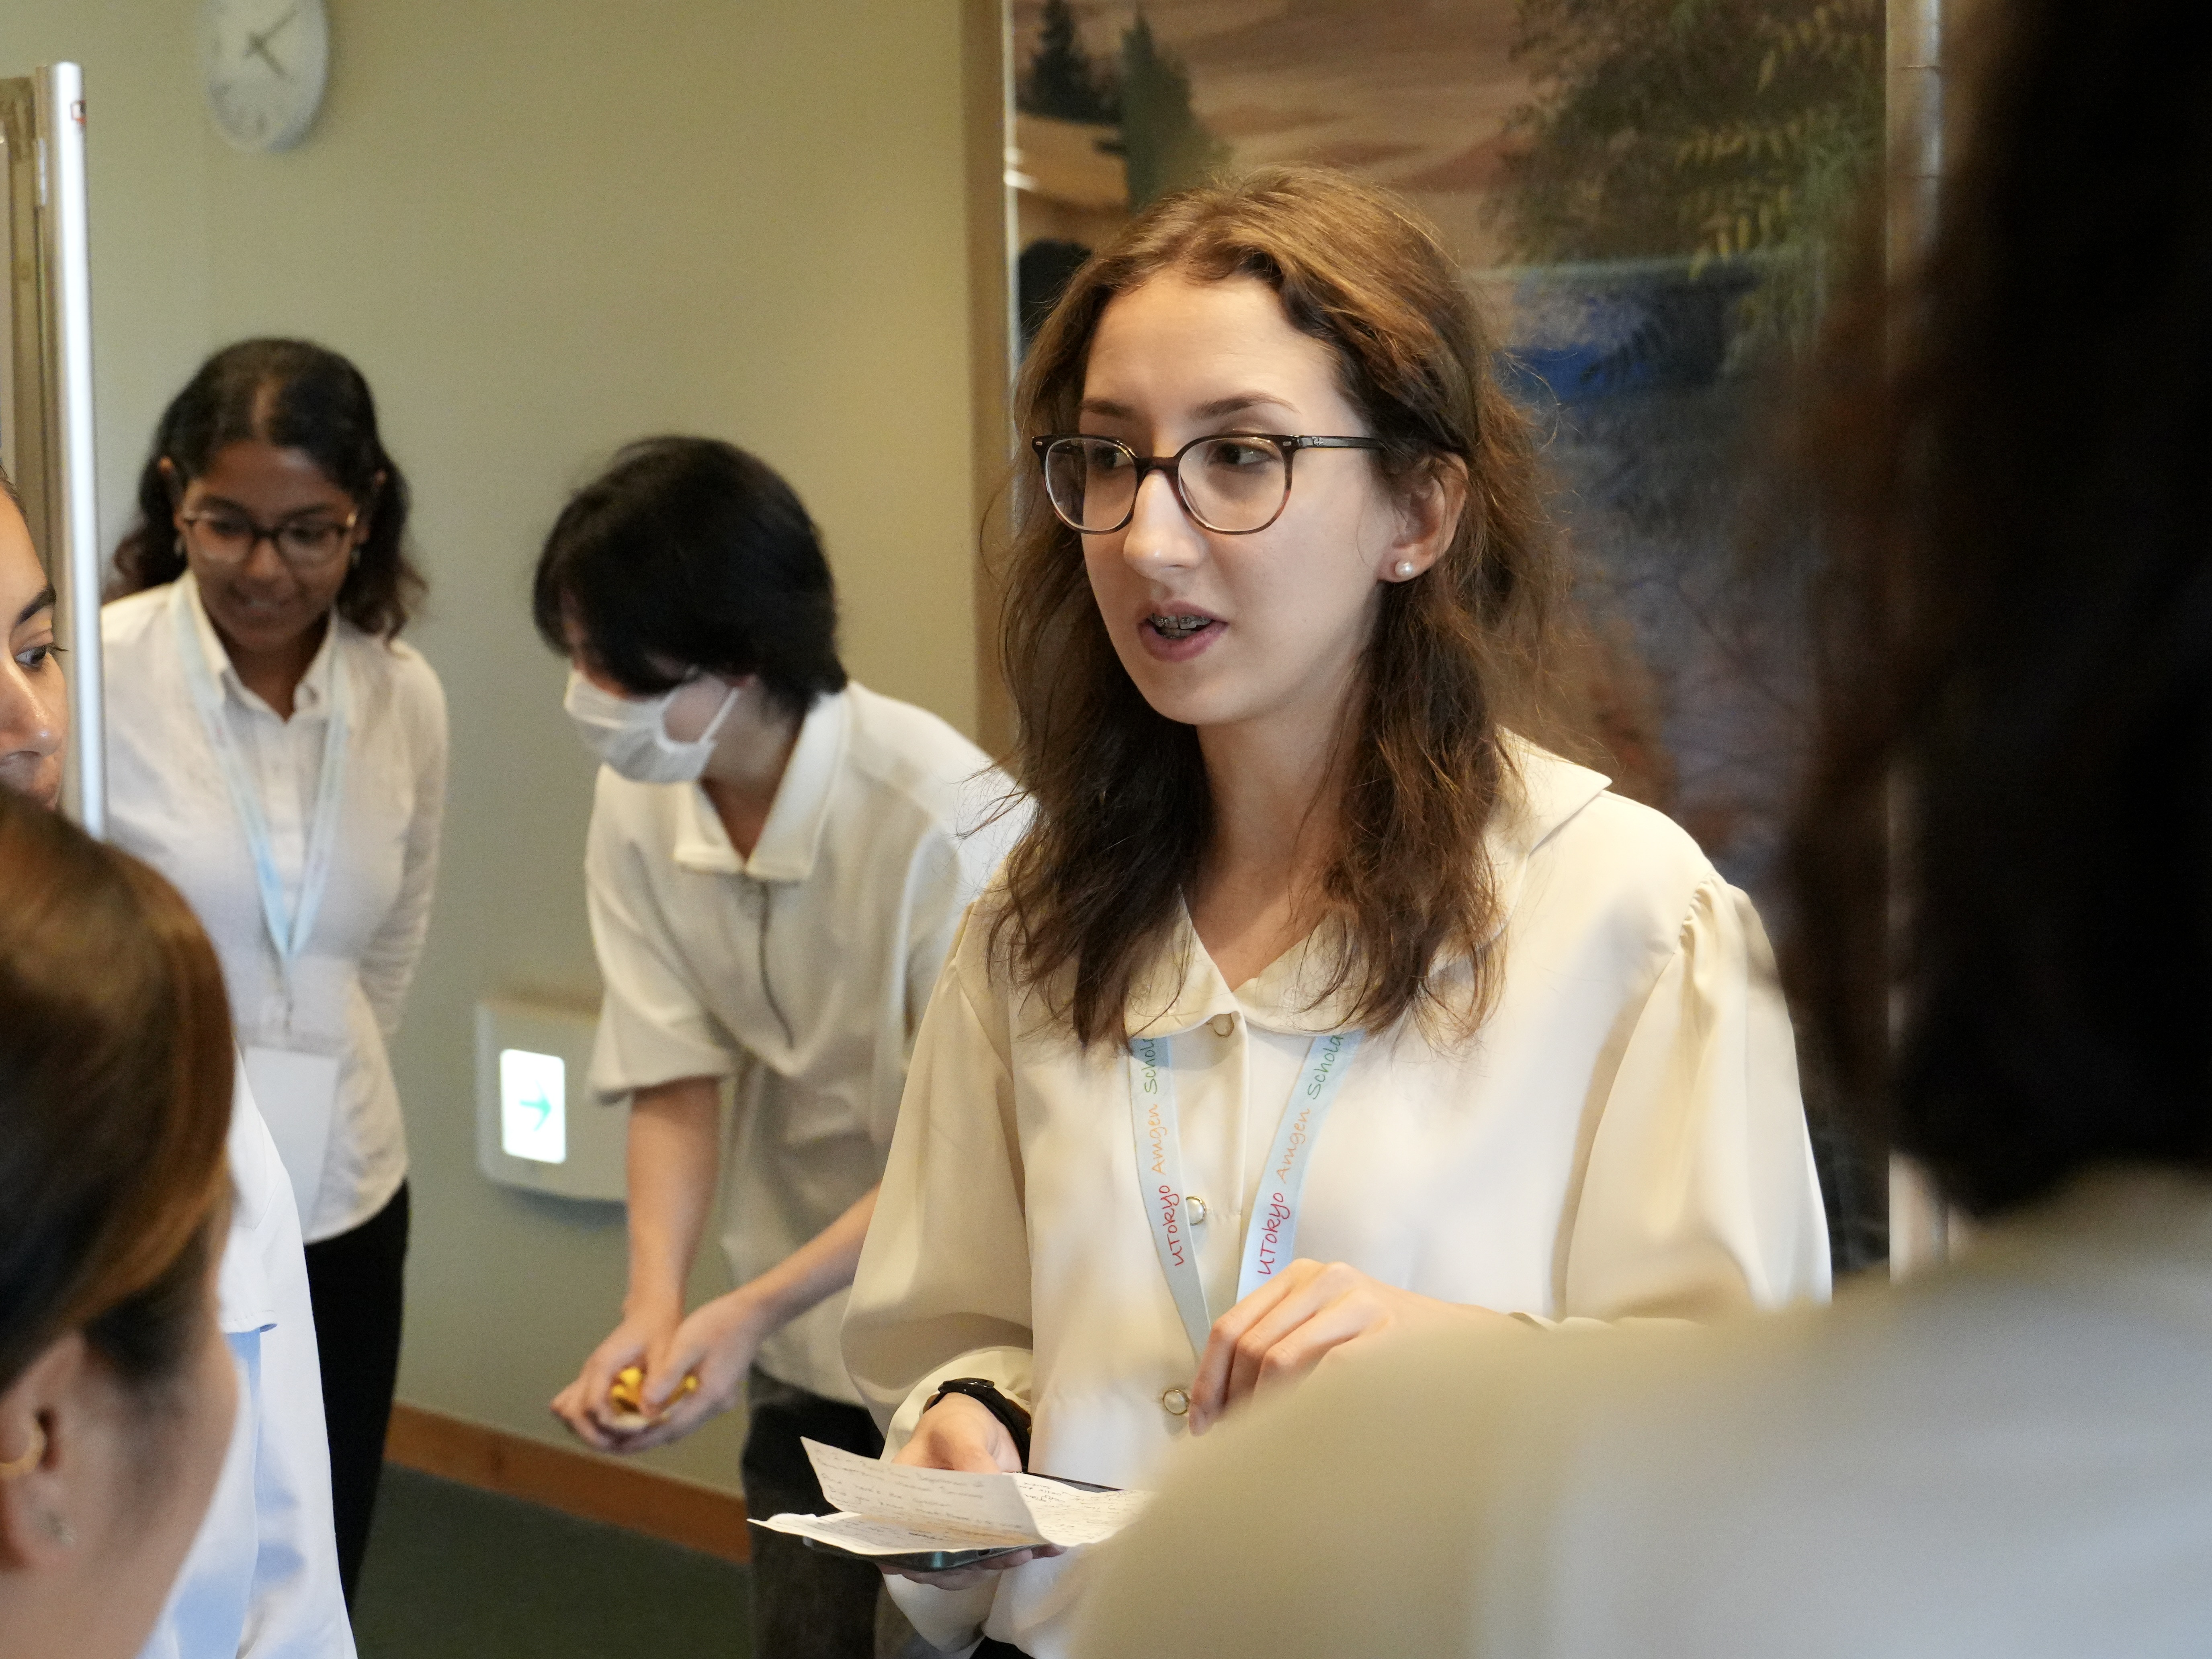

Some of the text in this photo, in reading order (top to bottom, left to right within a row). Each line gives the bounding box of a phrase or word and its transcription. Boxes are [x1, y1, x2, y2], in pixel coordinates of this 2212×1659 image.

[1148, 1104, 1168, 1175] Amgen
[1159, 1185, 1185, 1266] UTokyo
[1258, 1192, 1290, 1275] UTokyo
[1276, 1108, 1311, 1184] Amgen
